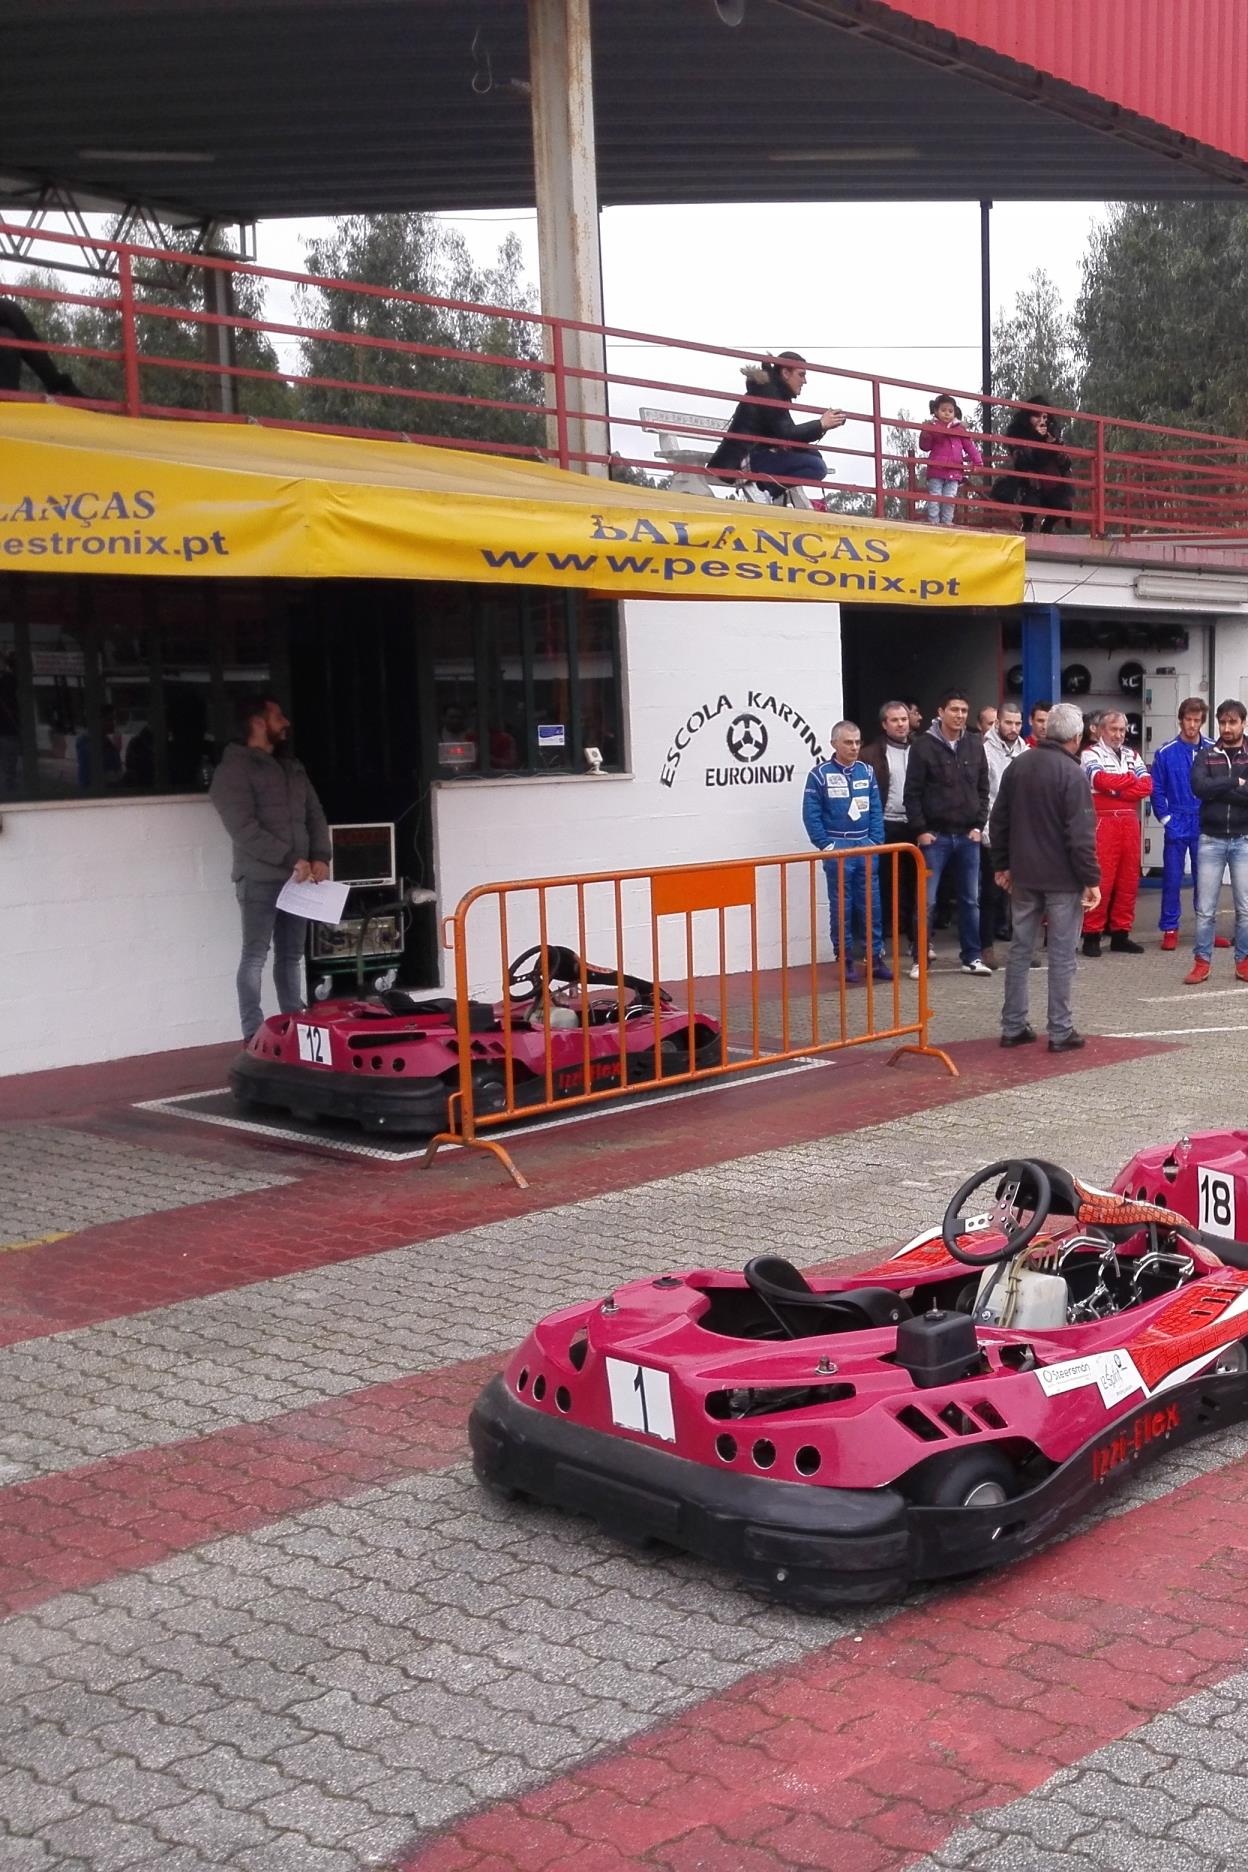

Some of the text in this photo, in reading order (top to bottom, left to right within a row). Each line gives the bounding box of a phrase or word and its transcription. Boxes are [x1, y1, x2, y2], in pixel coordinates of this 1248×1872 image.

[0, 530, 230, 562] estronix.pt
[590, 514, 890, 564] BALANÇAS
[480, 549, 961, 600] www.pestronix.pt
[660, 694, 733, 788] ESCOLA
[705, 764, 795, 787] EUROINDY
[306, 1026, 323, 1063] 12
[1201, 1174, 1231, 1226] 18
[633, 1366, 649, 1433] 1
